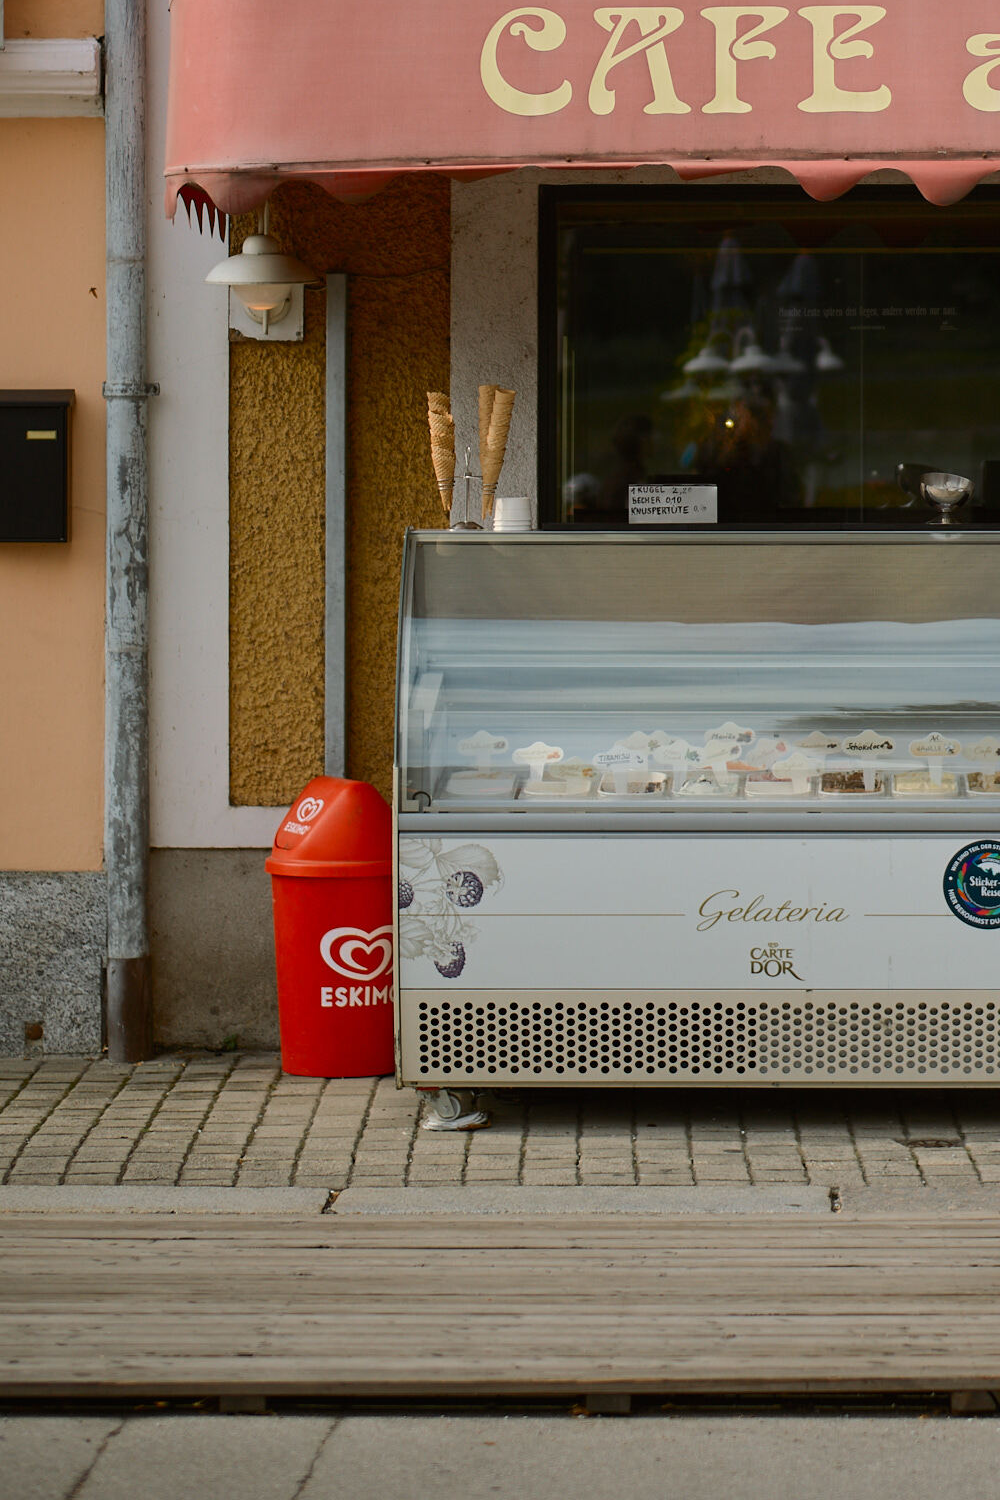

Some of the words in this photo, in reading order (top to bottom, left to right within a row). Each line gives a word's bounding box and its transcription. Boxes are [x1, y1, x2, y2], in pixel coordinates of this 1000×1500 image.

[480, 5, 893, 117] CAFE
[637, 486, 665, 494] KUGEL
[632, 496, 661, 505] BECHER
[968, 845, 980, 853] TEIL
[696, 889, 850, 932] Gelateria
[948, 889, 957, 904] HIER
[954, 904, 989, 925] BEKOMMST
[750, 947, 796, 962] CARTE
[750, 958, 807, 982] D'OR
